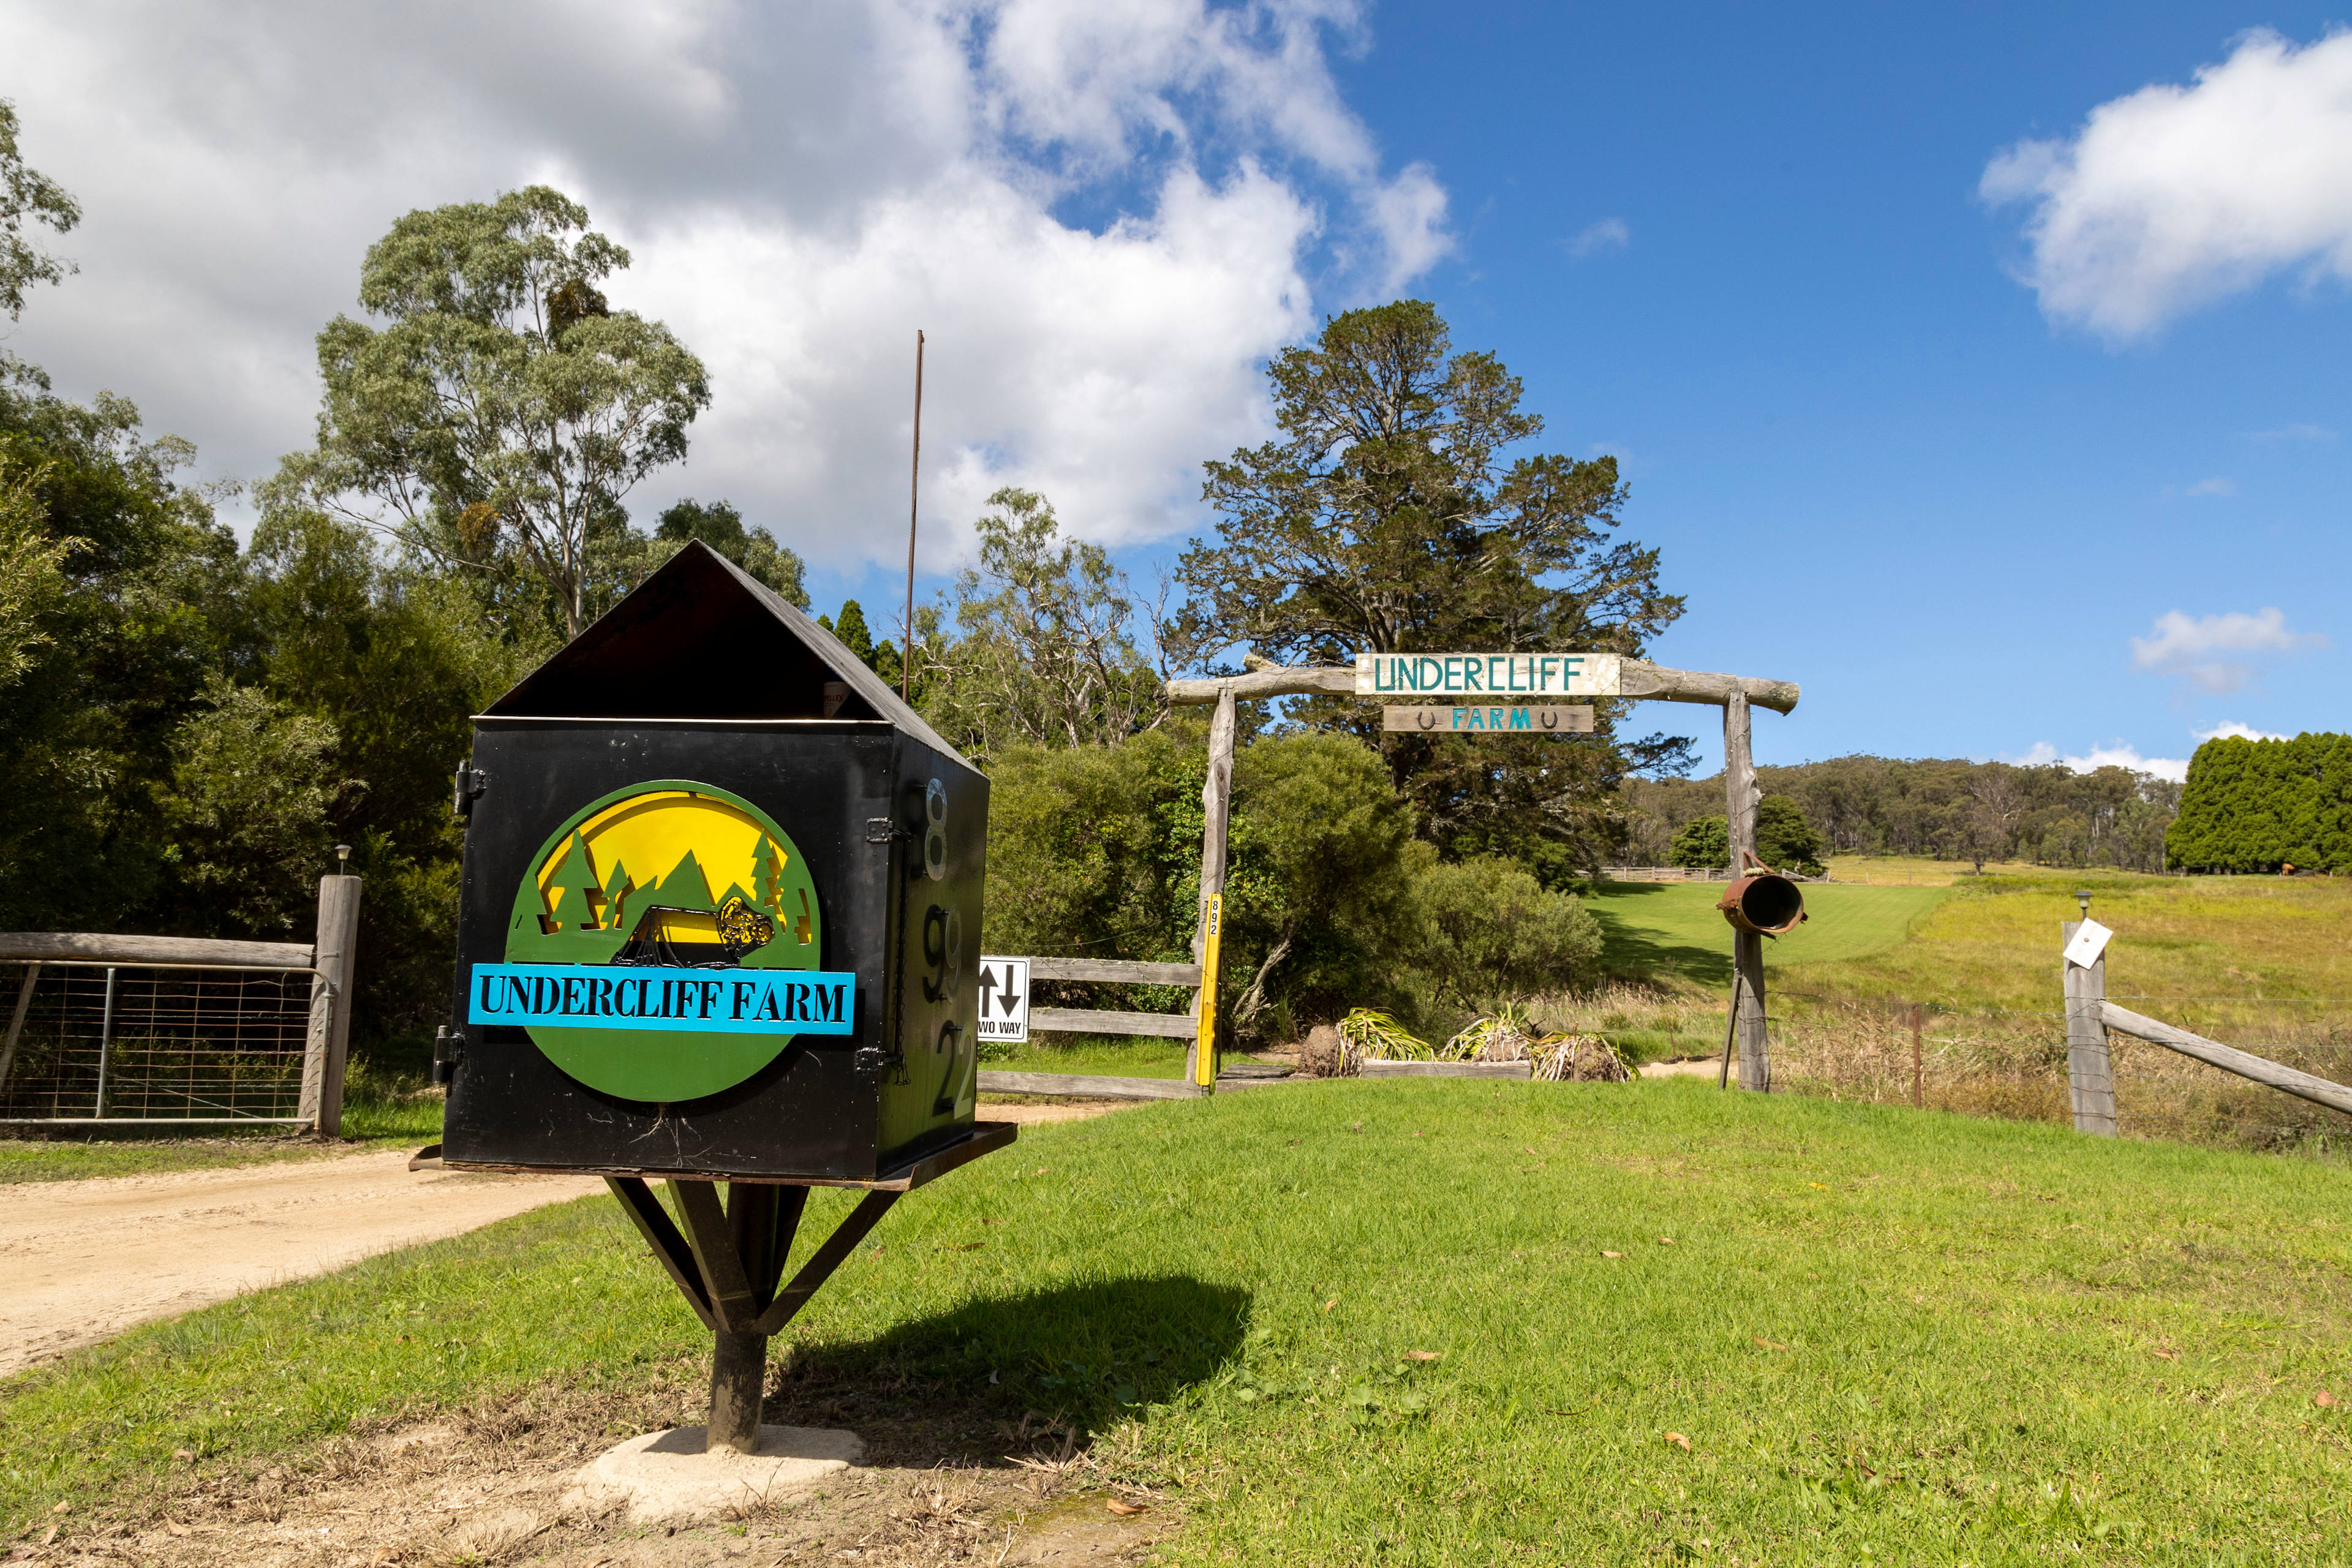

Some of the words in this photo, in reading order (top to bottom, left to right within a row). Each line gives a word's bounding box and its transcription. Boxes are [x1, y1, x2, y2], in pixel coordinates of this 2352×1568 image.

[1374, 657, 1585, 692] UNDERCLIFF
[1452, 708, 1532, 730] FARM
[479, 975, 723, 1020] UNDERCLIFF
[728, 981, 848, 1023] FARM
[978, 1021, 995, 1033] WO
[999, 1022, 1021, 1034] WAY
